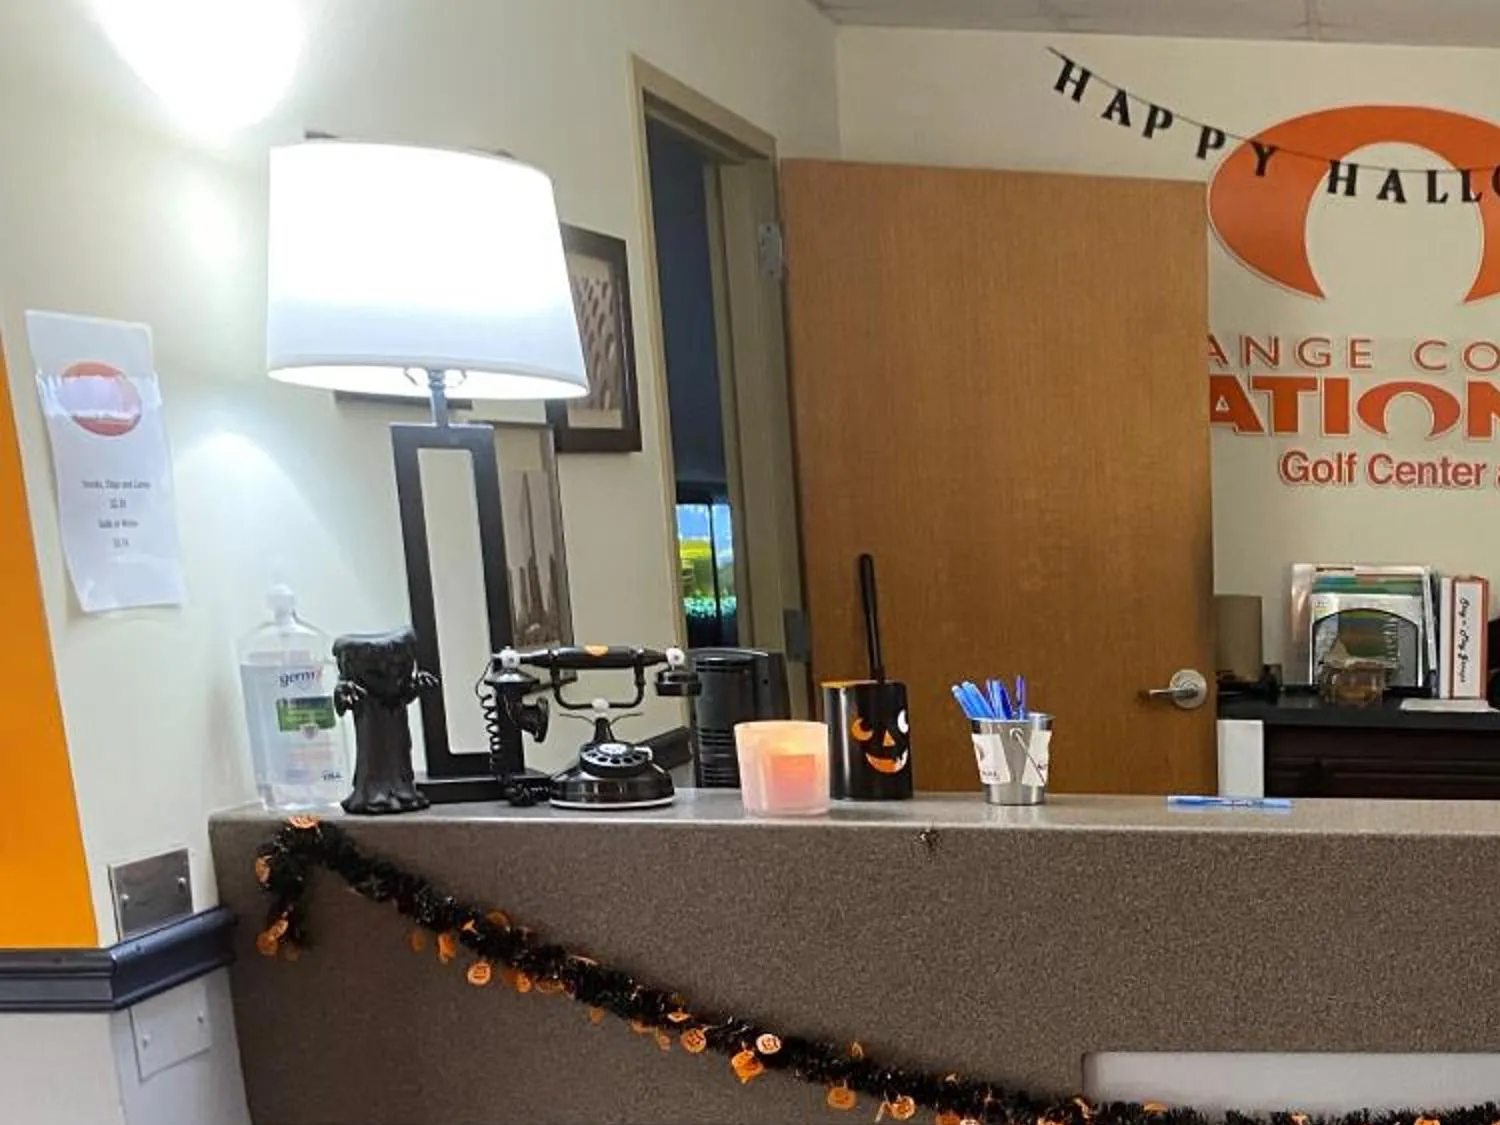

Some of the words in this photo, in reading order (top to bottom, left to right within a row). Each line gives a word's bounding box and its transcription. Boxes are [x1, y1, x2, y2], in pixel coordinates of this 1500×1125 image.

[1053, 55, 1278, 177] HAPPY
[1208, 334, 1374, 369] ANGE
[1280, 450, 1358, 484] Golf
[1367, 453, 1487, 487] Center
